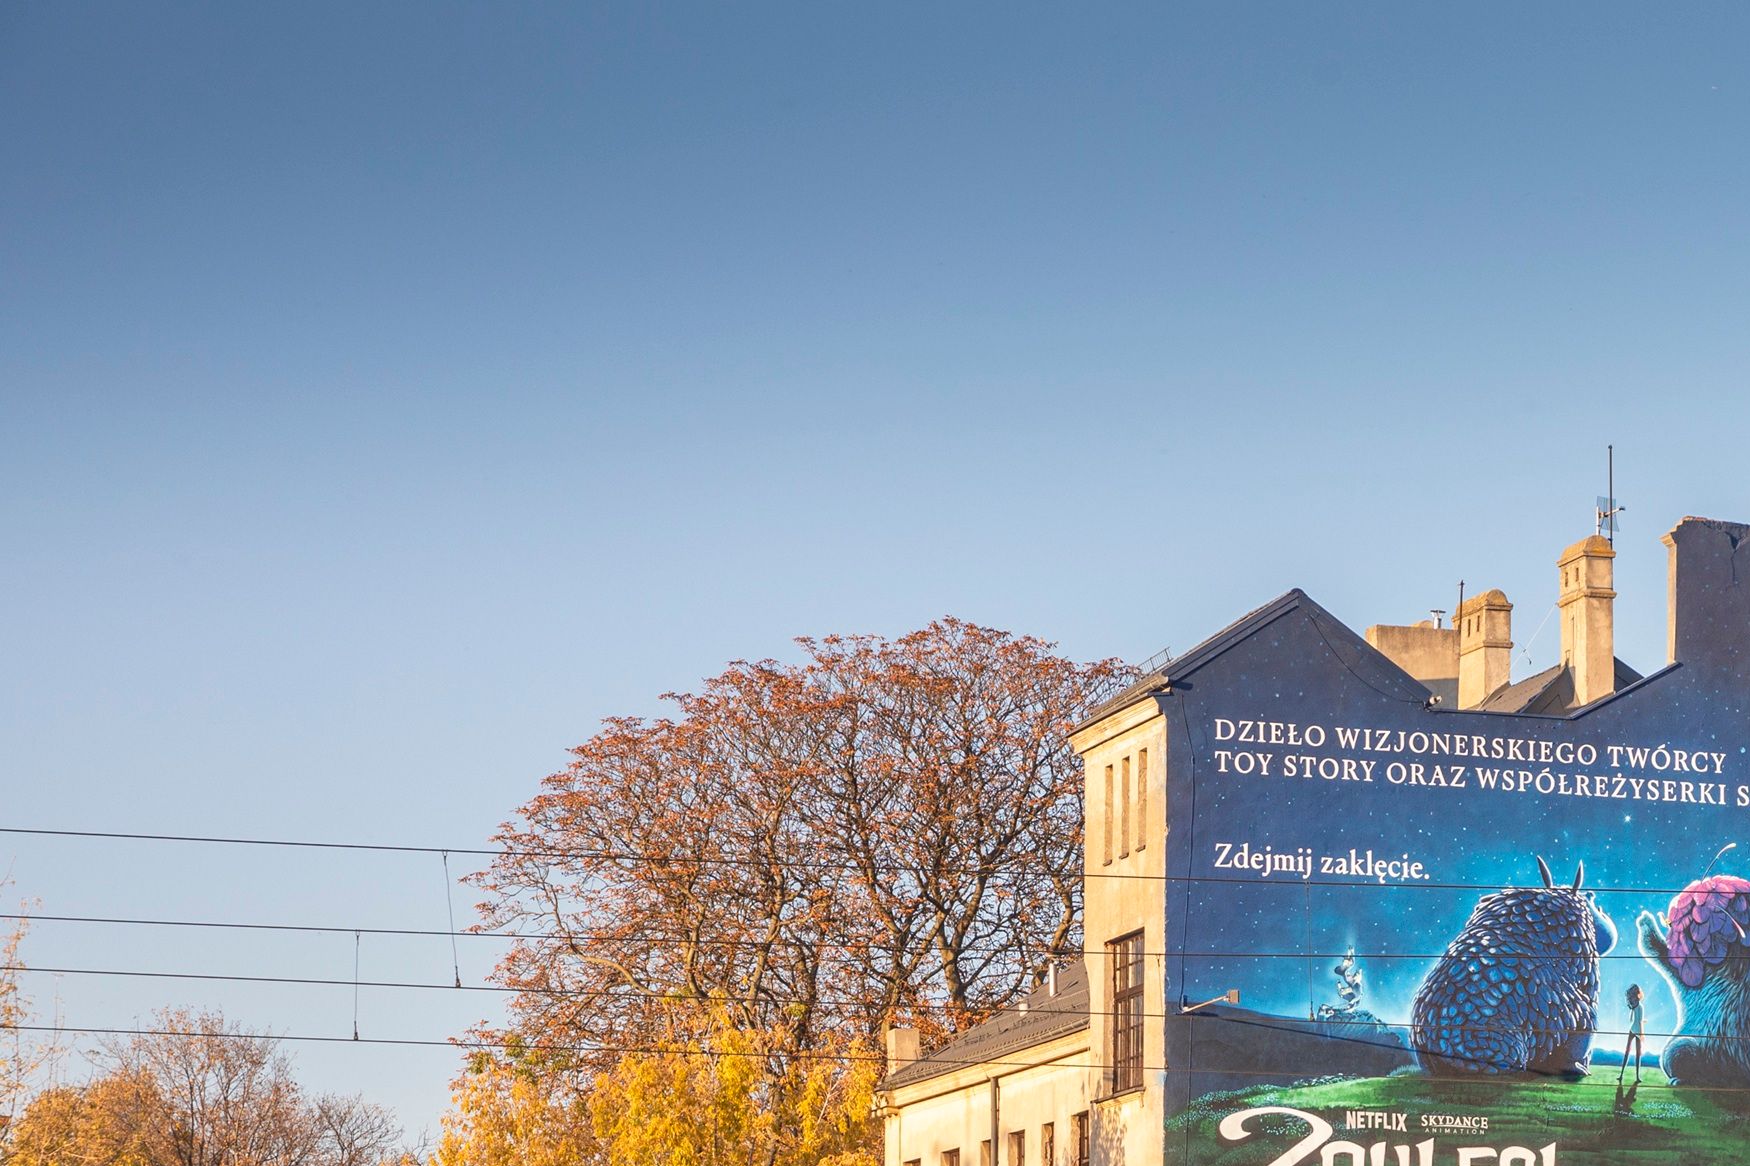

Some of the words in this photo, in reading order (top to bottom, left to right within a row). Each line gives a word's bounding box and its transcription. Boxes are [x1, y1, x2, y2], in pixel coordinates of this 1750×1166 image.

[1214, 719, 1326, 747] DZIEŁO
[1335, 727, 1597, 765] WIZJONERSKIEGO
[1607, 744, 1726, 774] TWÓRCY
[1215, 751, 1272, 775] TOY
[1283, 755, 1376, 783] STORY
[1386, 762, 1466, 788] ORAZ
[1476, 767, 1726, 805] WSPÓŁREŻYSERKI
[1214, 843, 1312, 879] Zdejmij
[1320, 849, 1430, 884] zaklęcie.
[1346, 1110, 1407, 1132] NETFLIX
[1421, 1115, 1488, 1129] SKYDANCE
